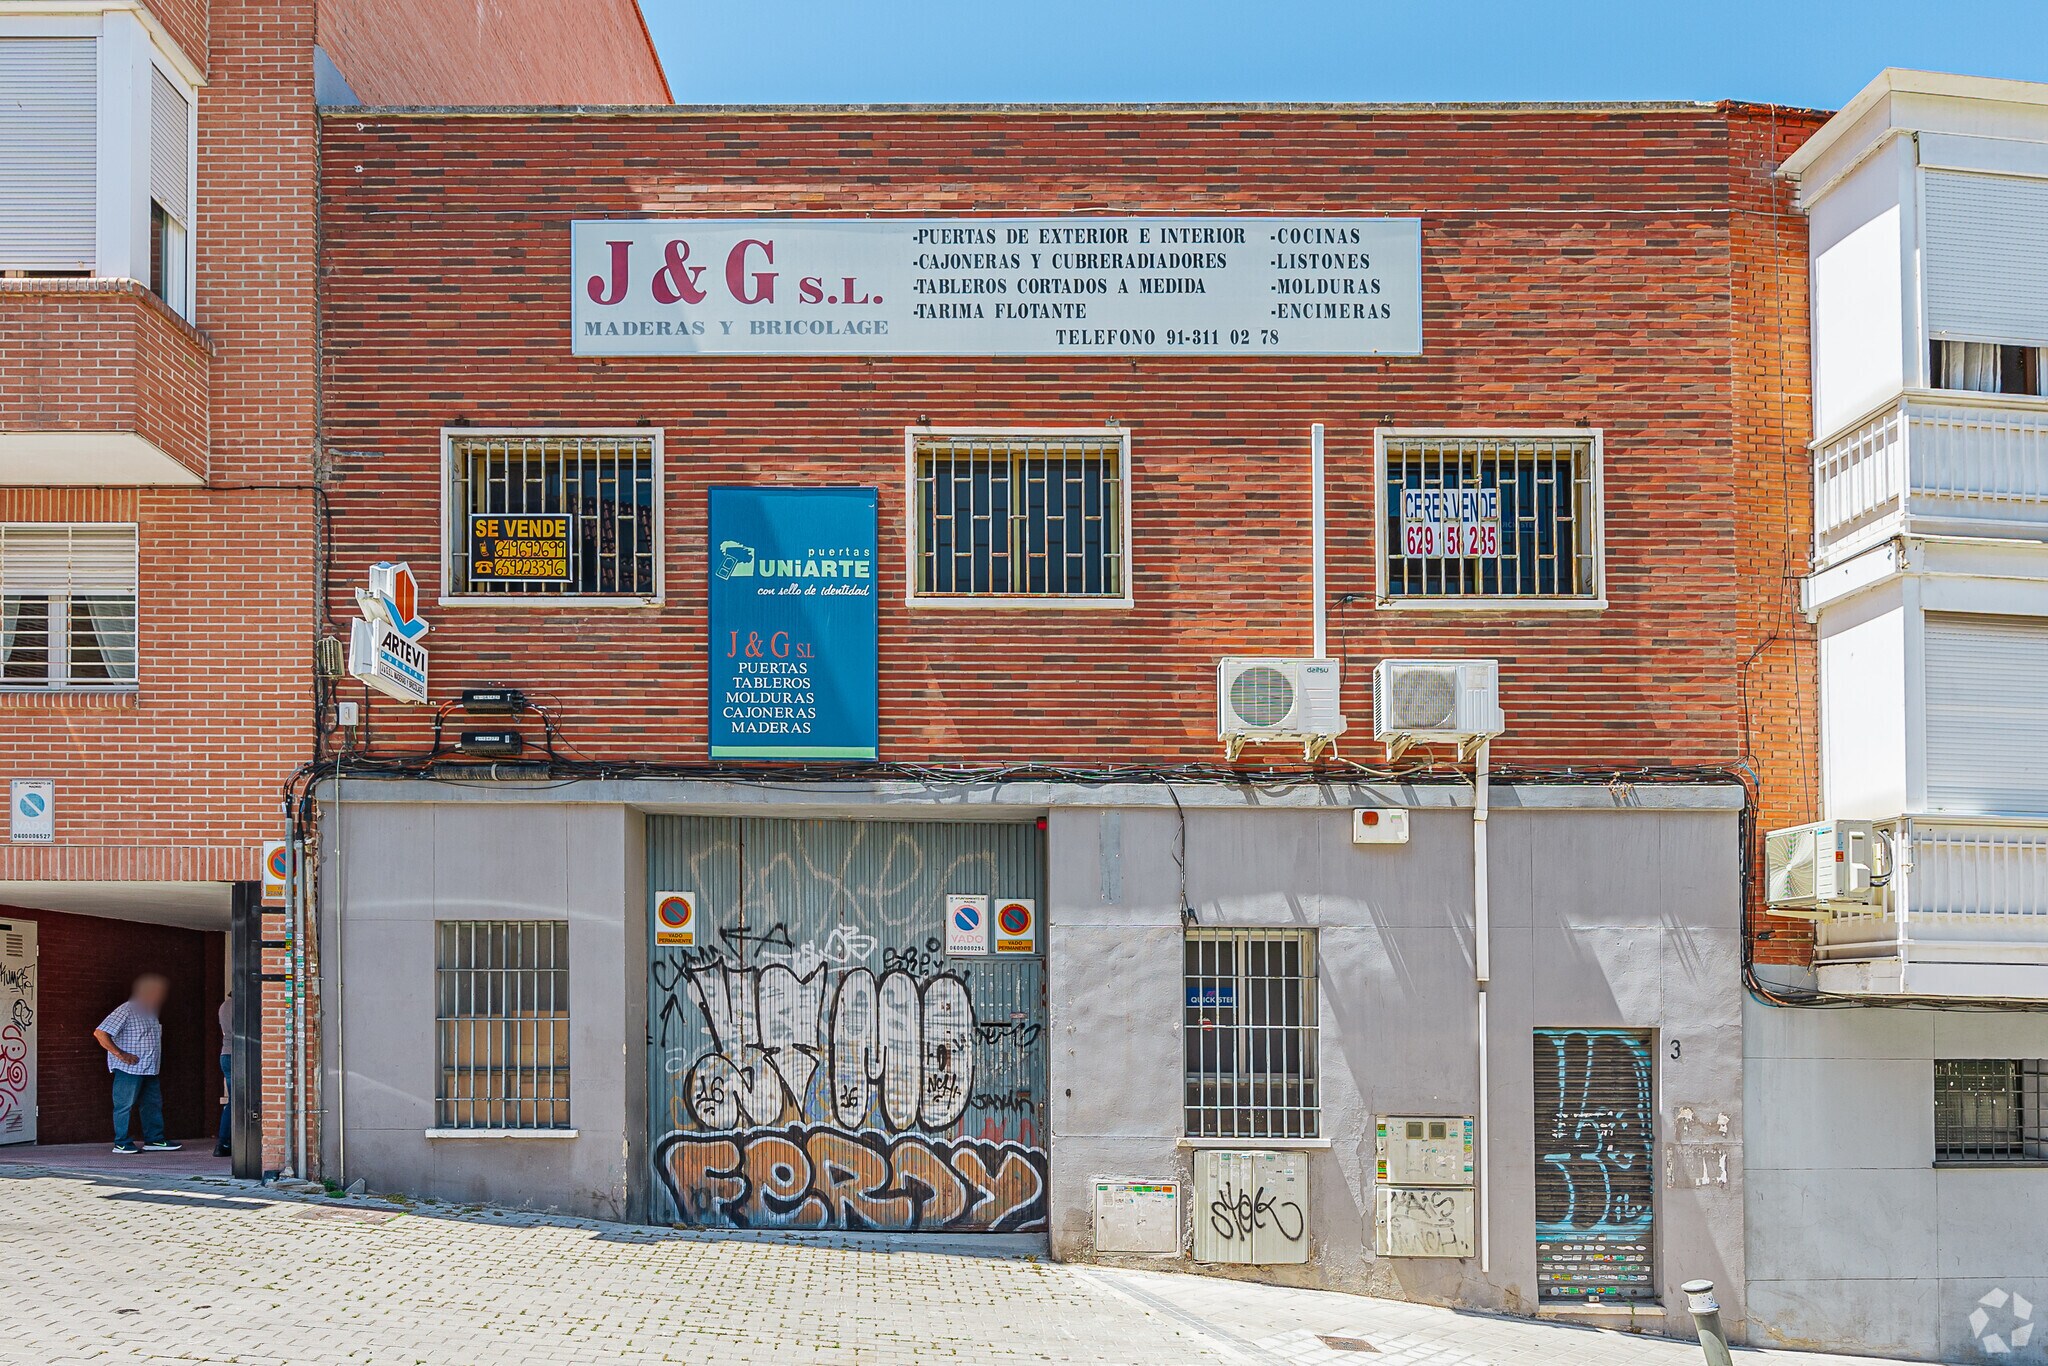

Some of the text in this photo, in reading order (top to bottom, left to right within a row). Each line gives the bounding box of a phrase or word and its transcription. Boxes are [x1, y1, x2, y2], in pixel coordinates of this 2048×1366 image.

[912, 227, 1247, 245] -PUERTAS DE EXTERIOR E INTERIOR
[1270, 227, 1361, 245] -COCINAS
[912, 252, 1228, 270] -CAJONERAS Y CUBRERADIADORES
[1270, 252, 1371, 270] -LISTONES
[587, 239, 885, 306] J & G S.L.
[912, 277, 1206, 295] -TABLEROS CORTADOS A MEDIDA
[1271, 277, 1382, 295] -MOLDURAS
[912, 303, 1087, 320] -TARIMA FLOTANTE
[1271, 303, 1392, 320] -ENCIMERAS
[584, 319, 889, 336] MADERAS Y BRICOLAGE
[1055, 328, 1280, 346] TELEFONO 91-311 02 78
[1451, 492, 1497, 523] VENDE
[475, 519, 567, 538] SE VENDE
[1407, 526, 1496, 555] 629 58 235
[808, 547, 871, 558] puertas
[757, 586, 775, 596] con
[778, 583, 802, 596] sello
[804, 583, 816, 596] de
[381, 631, 425, 673] ARTEVI
[727, 630, 738, 659] J
[744, 631, 764, 659] &
[770, 631, 790, 659] G
[381, 652, 425, 683] PUERTAS
[738, 661, 808, 675] PUERTAS
[733, 677, 811, 689] TABLEROS
[726, 692, 815, 704] MOLDURAS
[723, 707, 816, 719] CAJONERAS
[731, 721, 811, 734] MADERAS
[950, 934, 984, 944] VADO
[1670, 1039, 1681, 1060] 3
